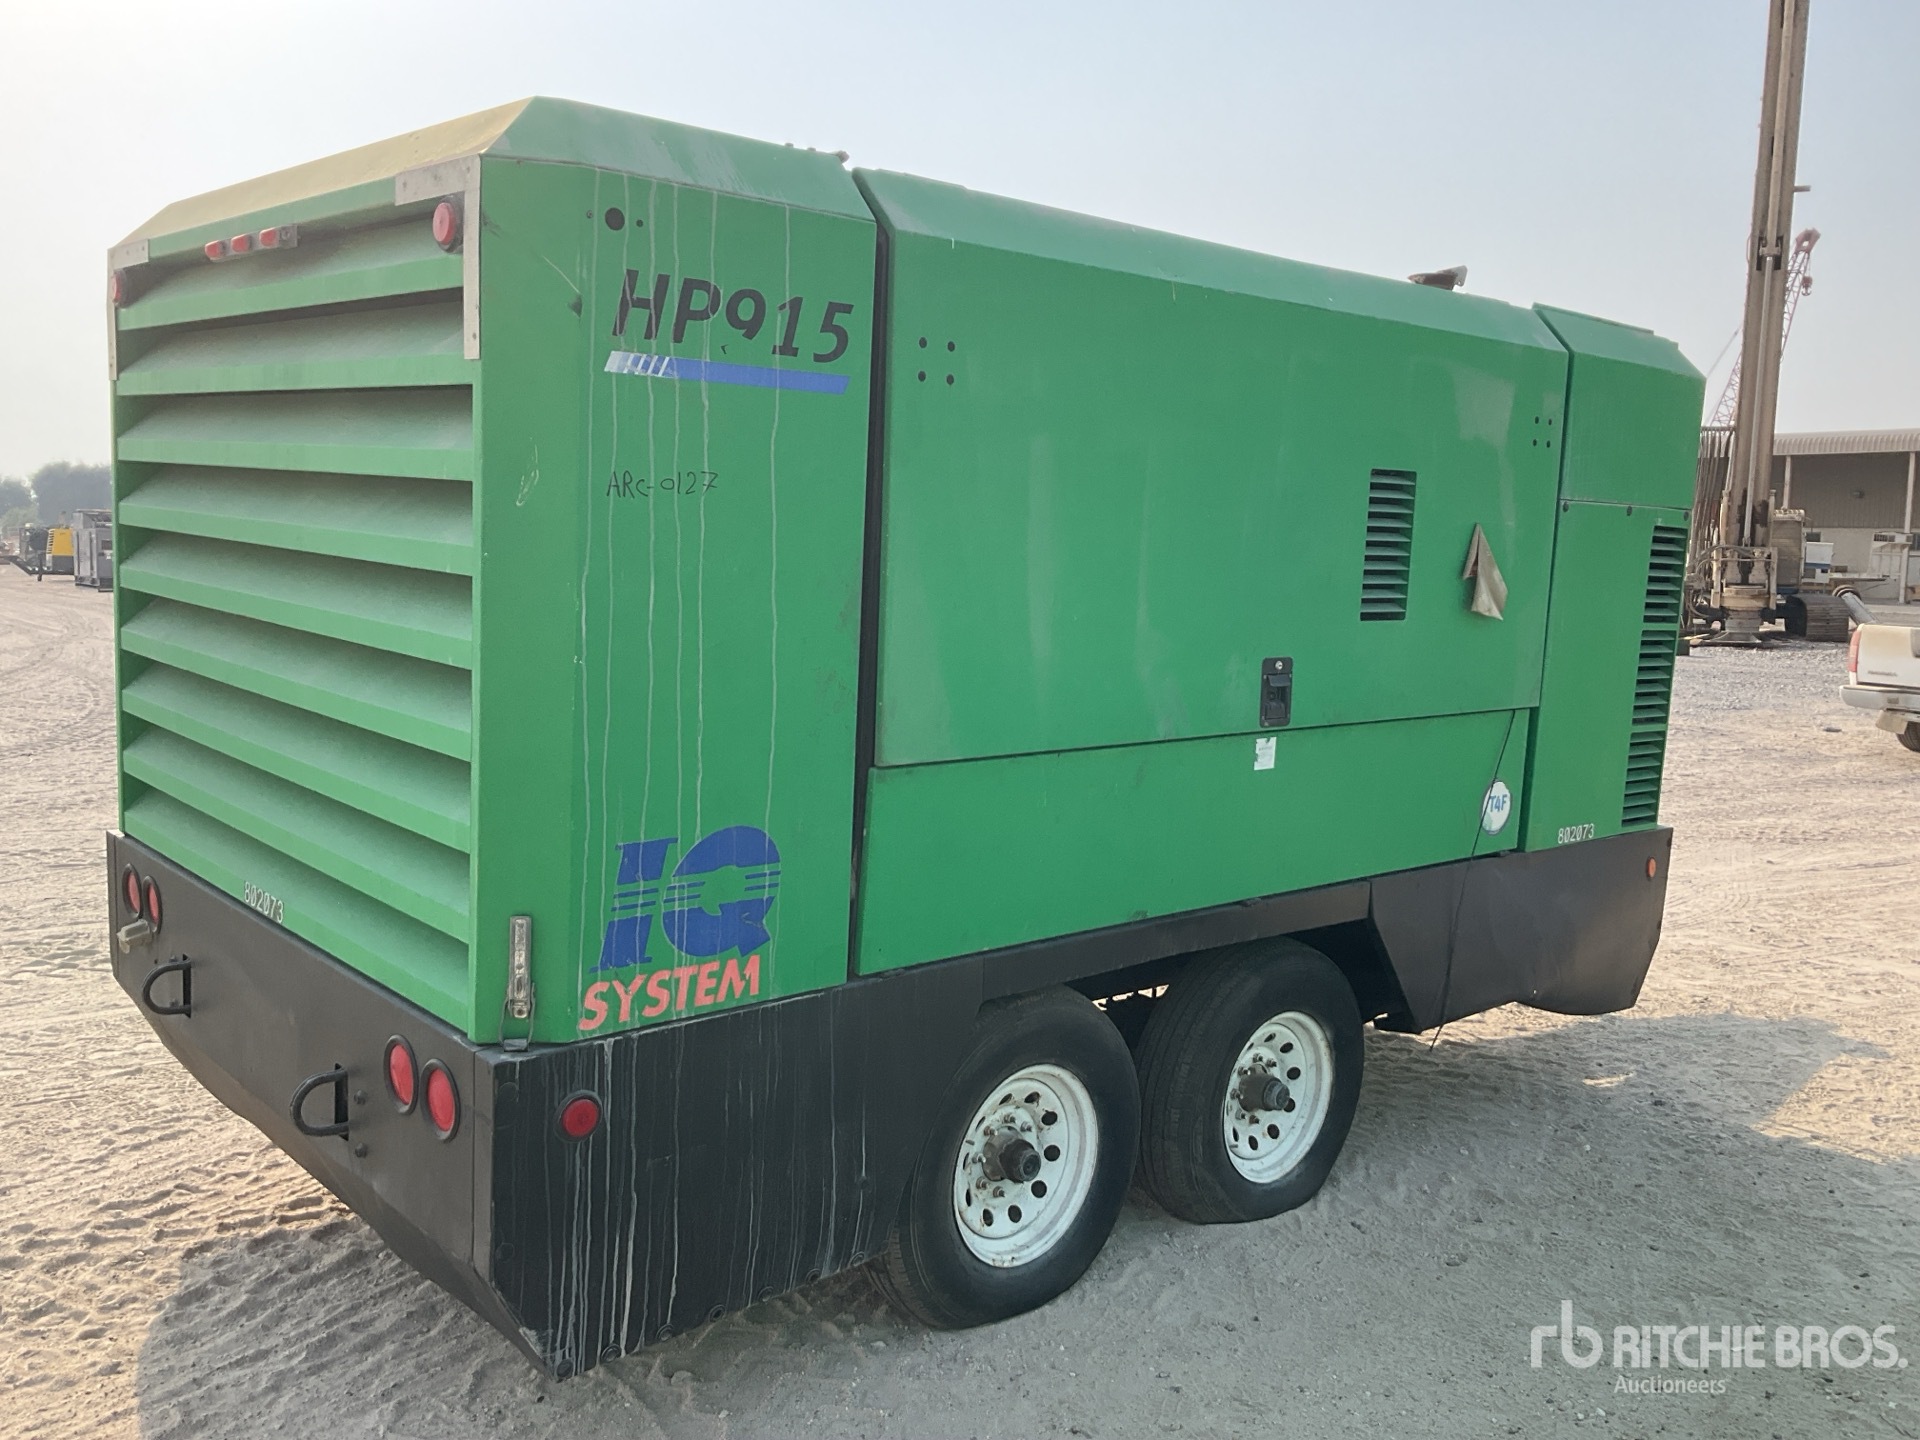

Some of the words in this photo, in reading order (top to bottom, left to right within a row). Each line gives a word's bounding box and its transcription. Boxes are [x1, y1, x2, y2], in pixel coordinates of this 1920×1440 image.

[611, 268, 855, 364] HP915
[1489, 794, 1507, 812] T4F
[1557, 823, 1595, 844] 802073
[244, 881, 284, 924] 802073
[588, 825, 782, 974] IQ
[578, 954, 761, 1031] SYSTEM
